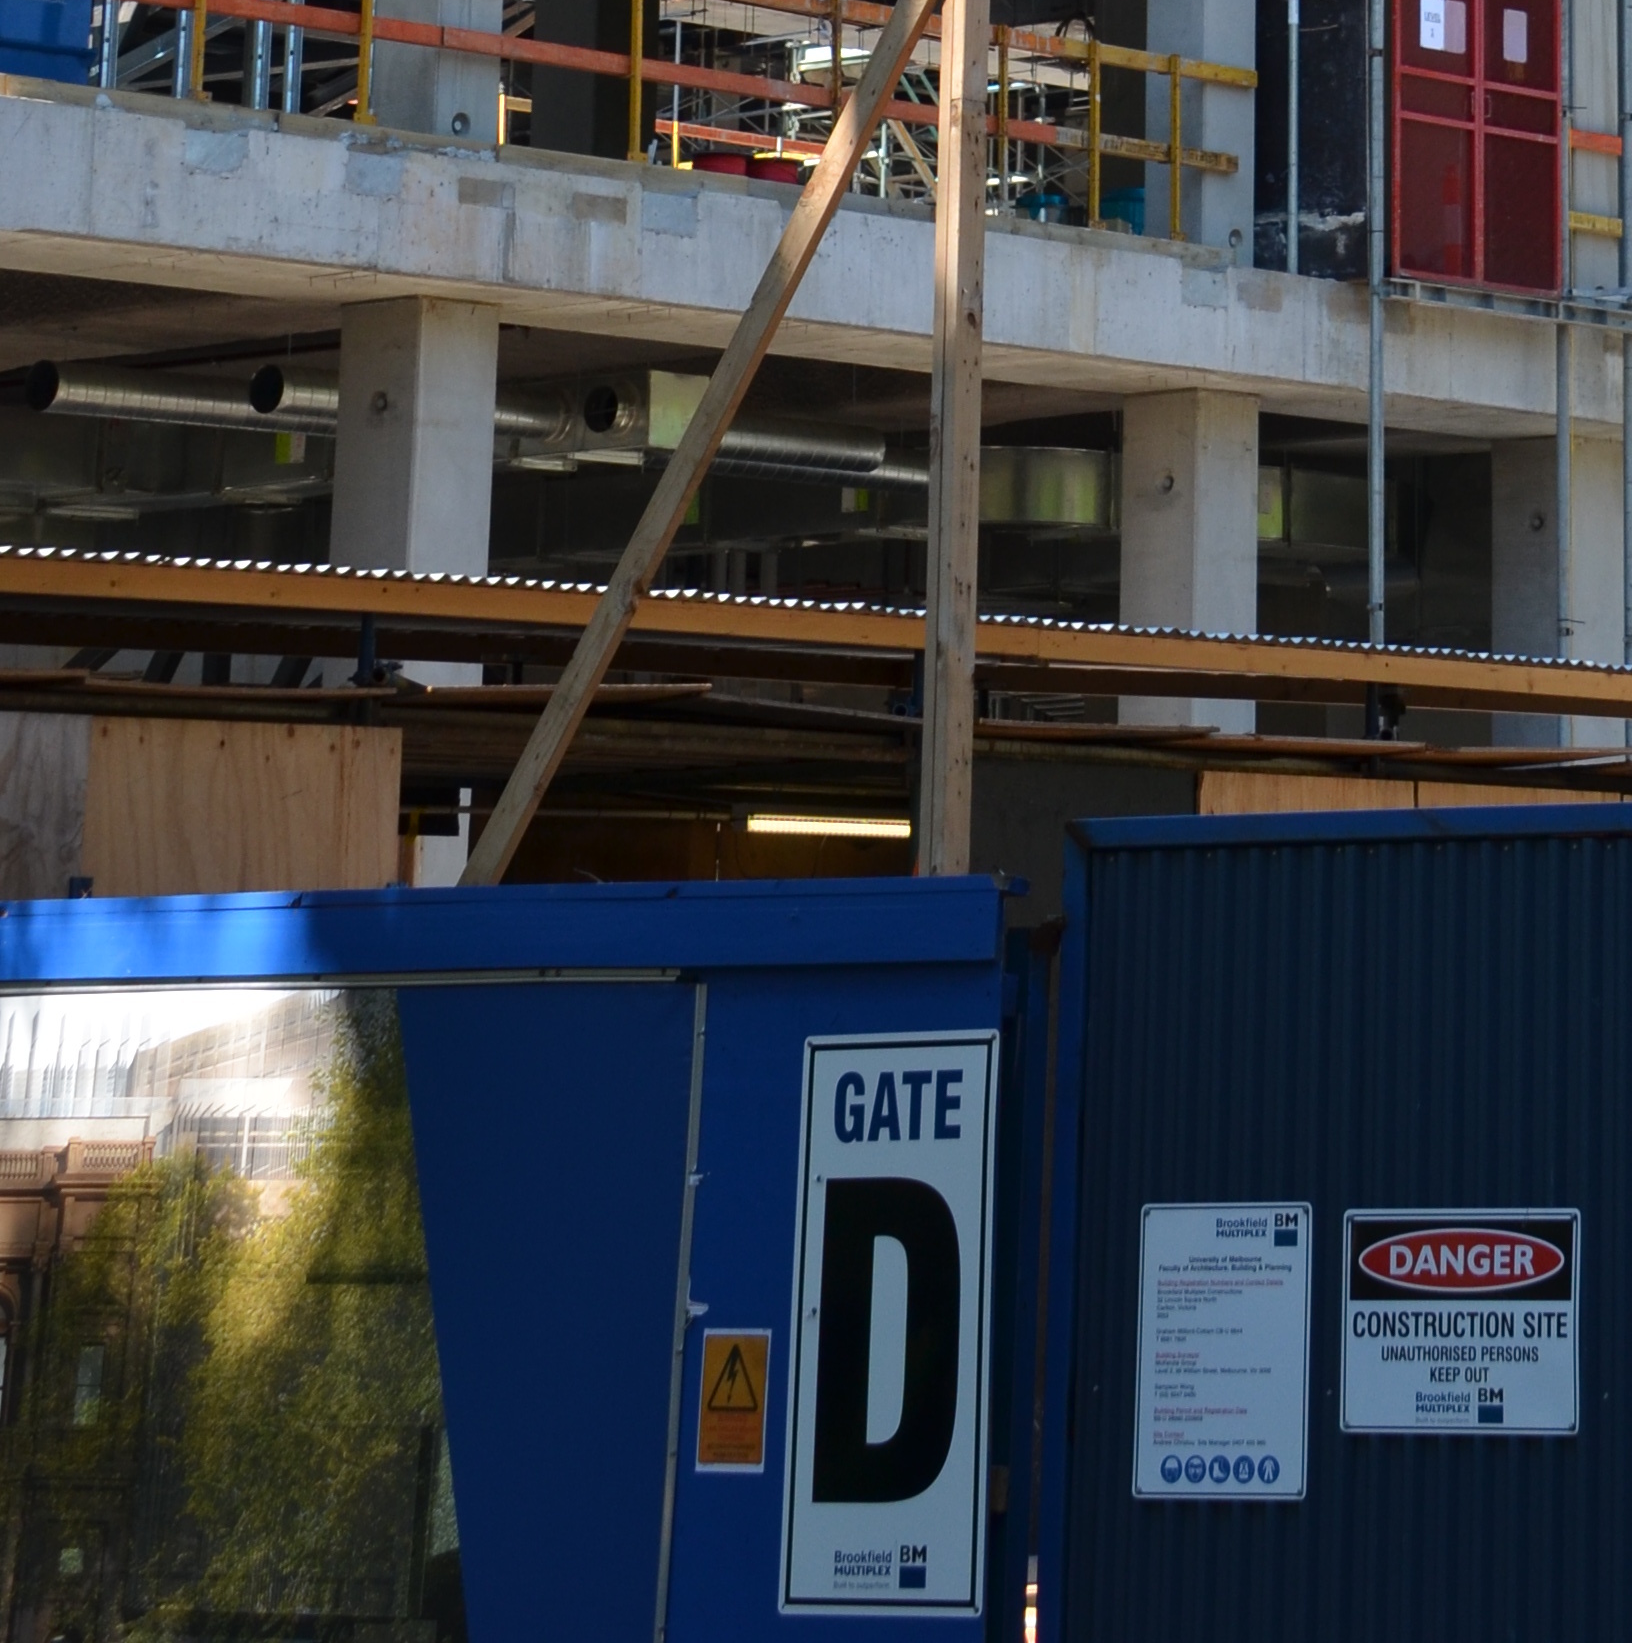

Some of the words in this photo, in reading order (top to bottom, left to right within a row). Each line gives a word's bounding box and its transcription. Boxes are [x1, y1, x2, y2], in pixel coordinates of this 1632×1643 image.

[833, 1068, 964, 1144] GATE
[1216, 1217, 1268, 1228] Brookfield
[1274, 1213, 1299, 1227] BM
[1216, 1229, 1267, 1238] MULTIPLEX
[1388, 1244, 1535, 1277] DANGER
[1352, 1310, 1518, 1340] CONSTRUCTION
[1522, 1310, 1568, 1339] SITE
[812, 1176, 961, 1504] D
[1381, 1345, 1477, 1363] UNAUTHORISED
[1480, 1345, 1540, 1363] PERSONS
[1429, 1366, 1460, 1384] KEEP
[1464, 1366, 1490, 1384] OUT
[1416, 1391, 1471, 1403] Brookfield
[1478, 1387, 1504, 1403] BM
[1416, 1404, 1470, 1413] MULTIPLEX
[834, 1549, 893, 1564] Brookfield
[900, 1544, 928, 1564] BM
[834, 1565, 891, 1576] MULTIPLEX
